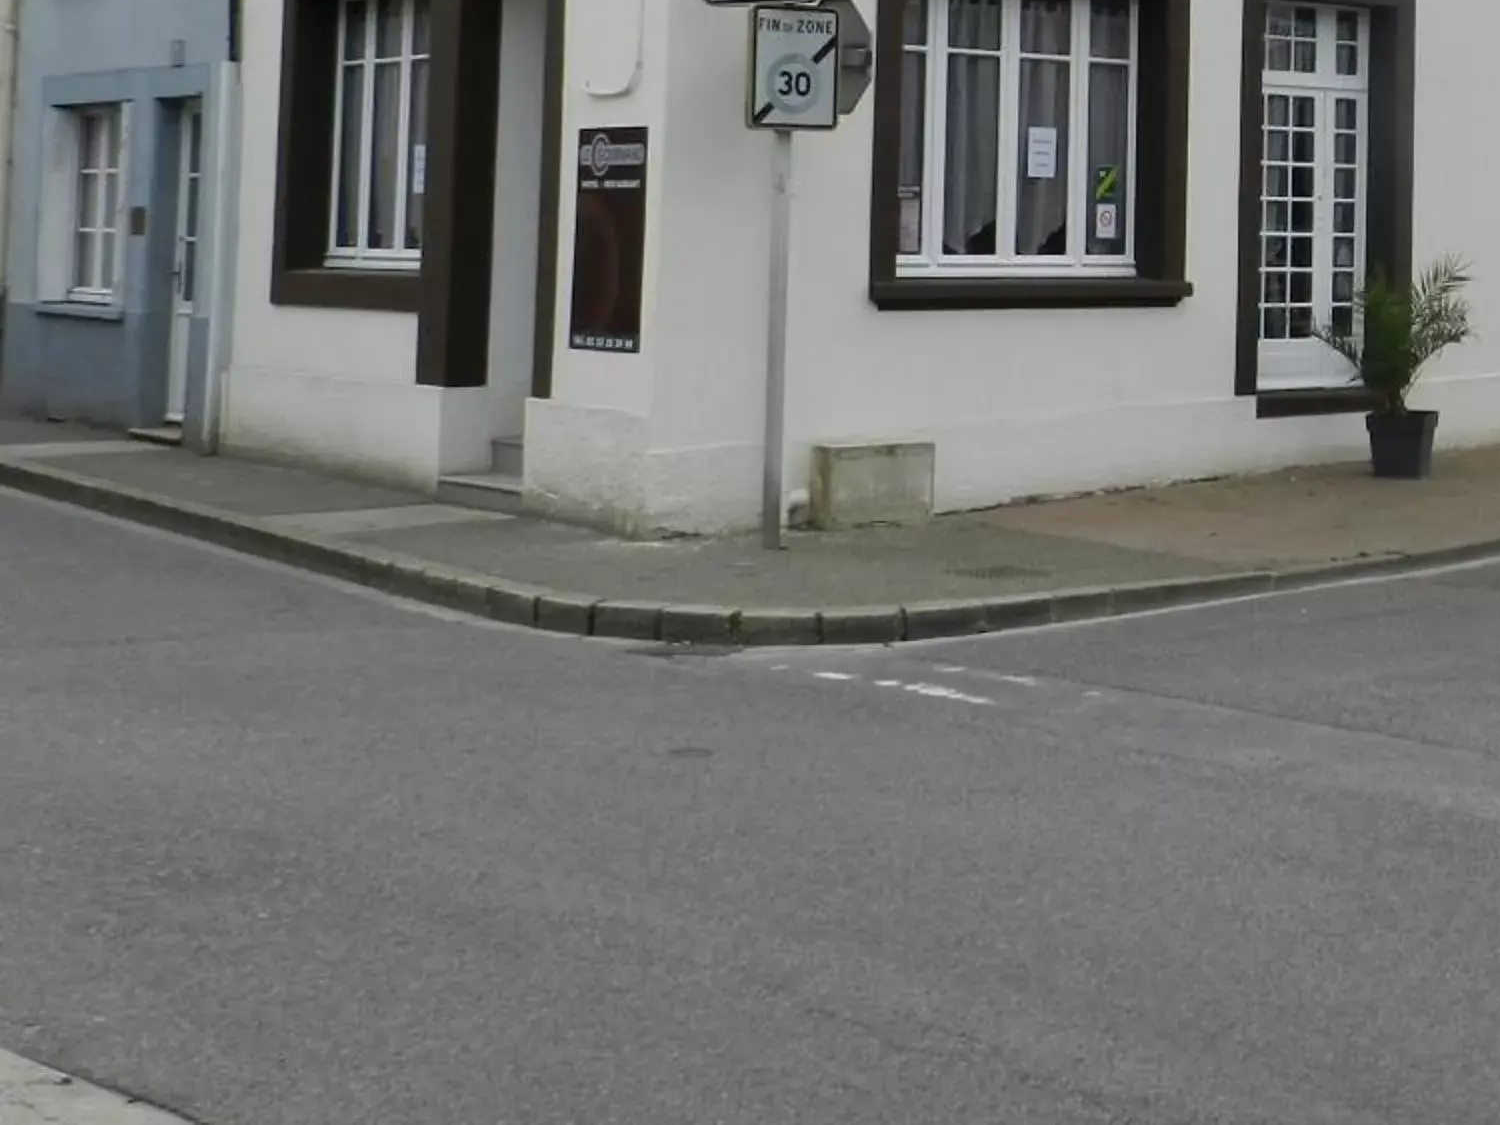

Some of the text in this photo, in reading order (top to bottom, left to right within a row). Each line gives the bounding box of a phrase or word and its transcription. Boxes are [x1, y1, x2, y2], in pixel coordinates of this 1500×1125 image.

[759, 17, 781, 32] FIN
[796, 19, 834, 35] ZONE
[777, 70, 812, 97] 30
